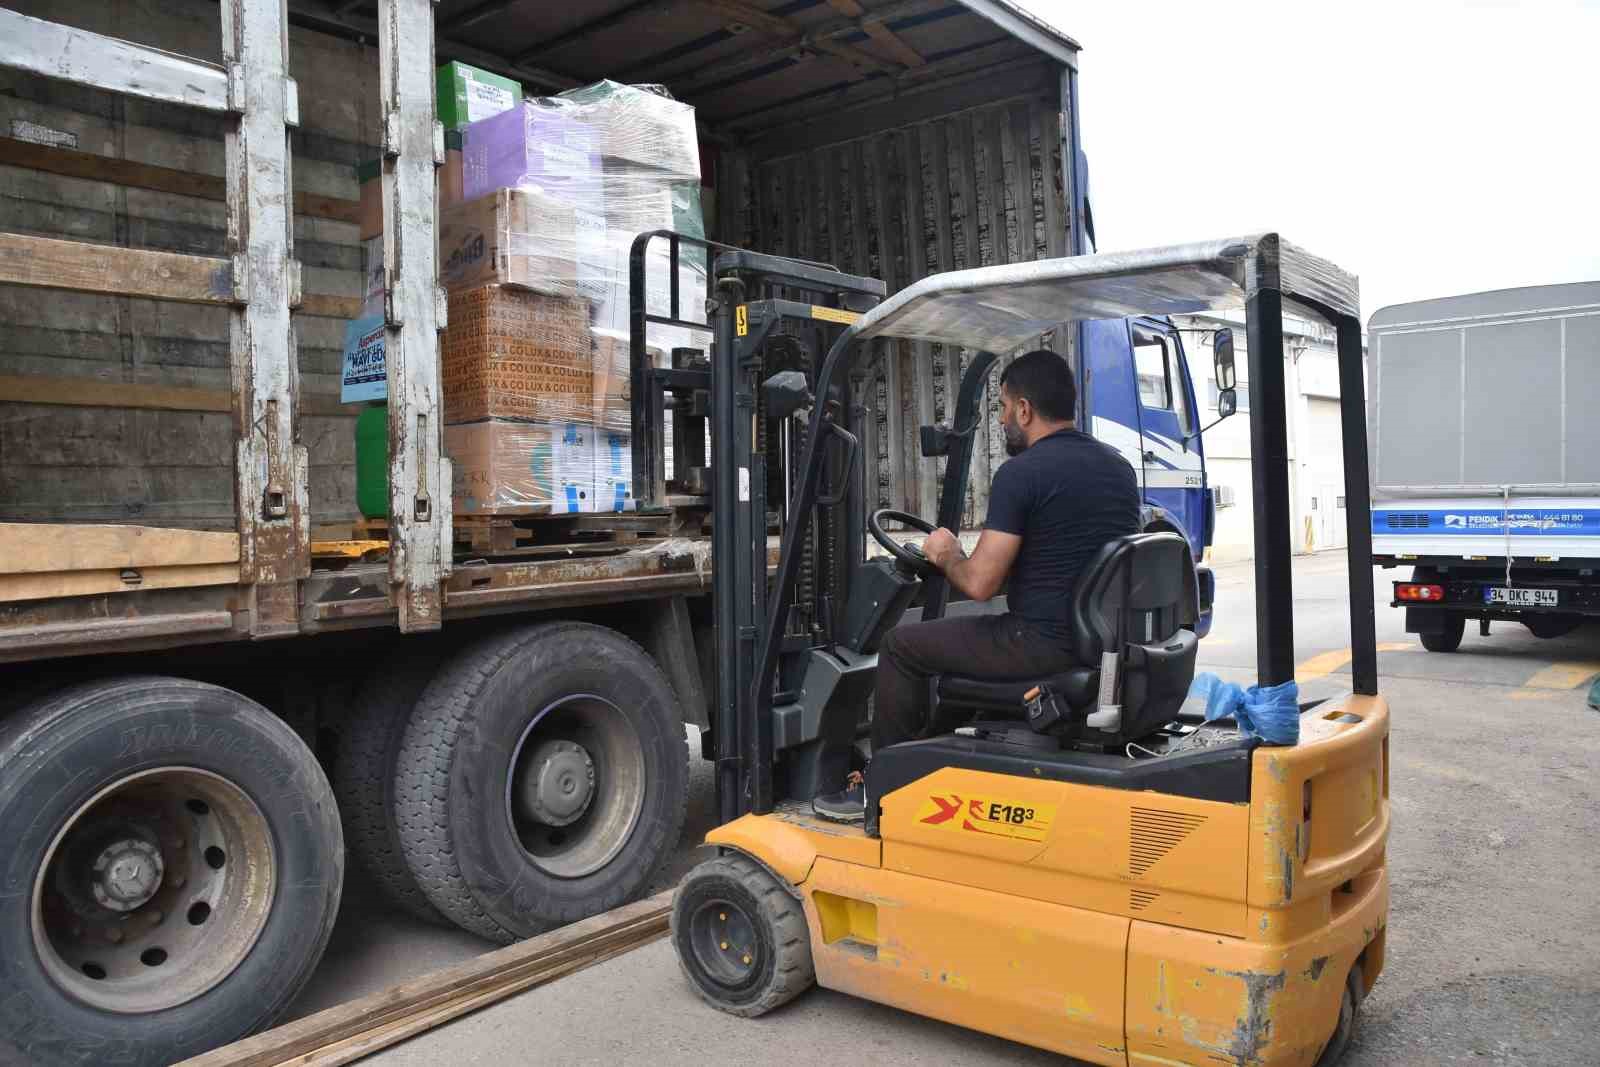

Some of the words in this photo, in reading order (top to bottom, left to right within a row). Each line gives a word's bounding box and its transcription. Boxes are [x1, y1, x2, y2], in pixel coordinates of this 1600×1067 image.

[1491, 589, 1503, 600] 34
[1509, 590, 1529, 601] DKC
[1534, 591, 1555, 602] 944
